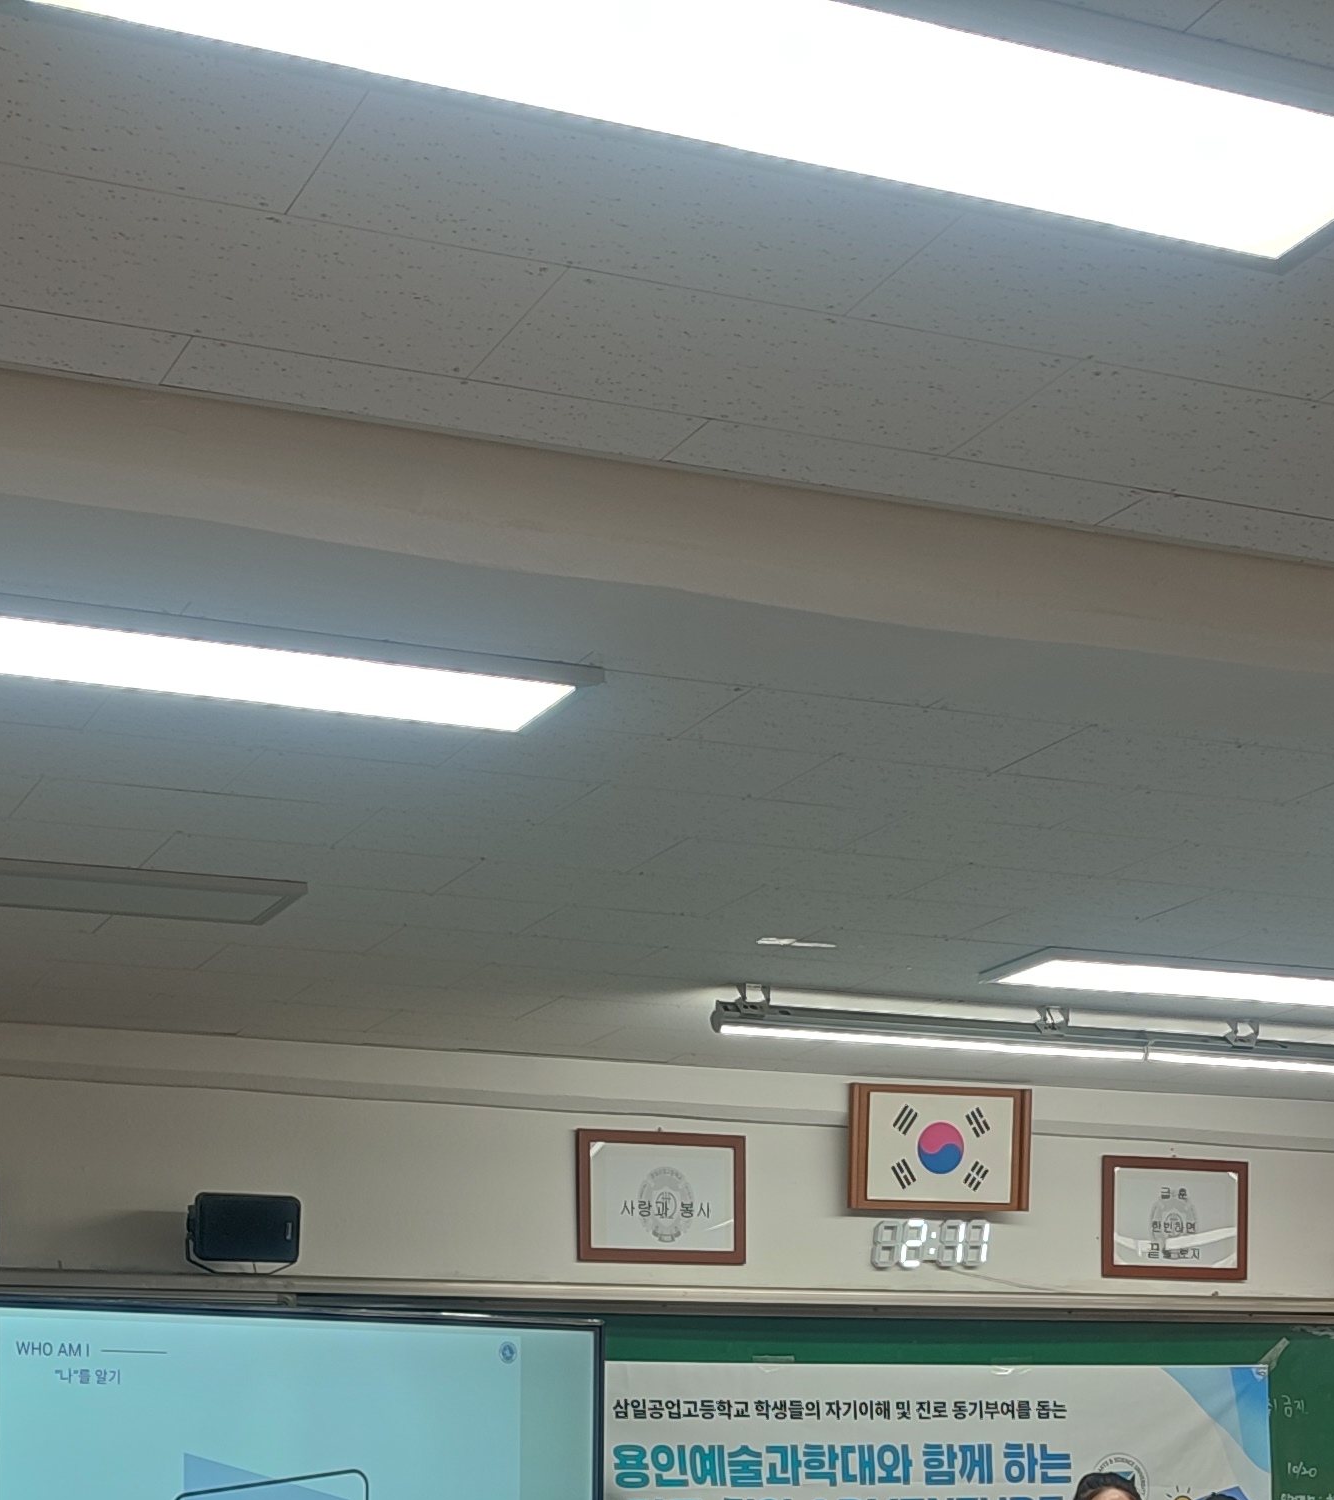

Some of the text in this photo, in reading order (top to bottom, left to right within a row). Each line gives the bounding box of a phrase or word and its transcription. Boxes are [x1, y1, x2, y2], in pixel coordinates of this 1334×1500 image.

[620, 1199, 711, 1219] 사랑과 봉사
[15, 1340, 54, 1357] WHO
[56, 1342, 82, 1358] AM
[95, 1368, 121, 1385] 알기
[611, 1398, 1067, 1421] 삼일공업고등학교 학생들의 자기이해 및 진로 동기부여를 돕는
[612, 1442, 1072, 1489] 용인예술과학대와 함께 하는
[1286, 1461, 1318, 1479] 10/20
